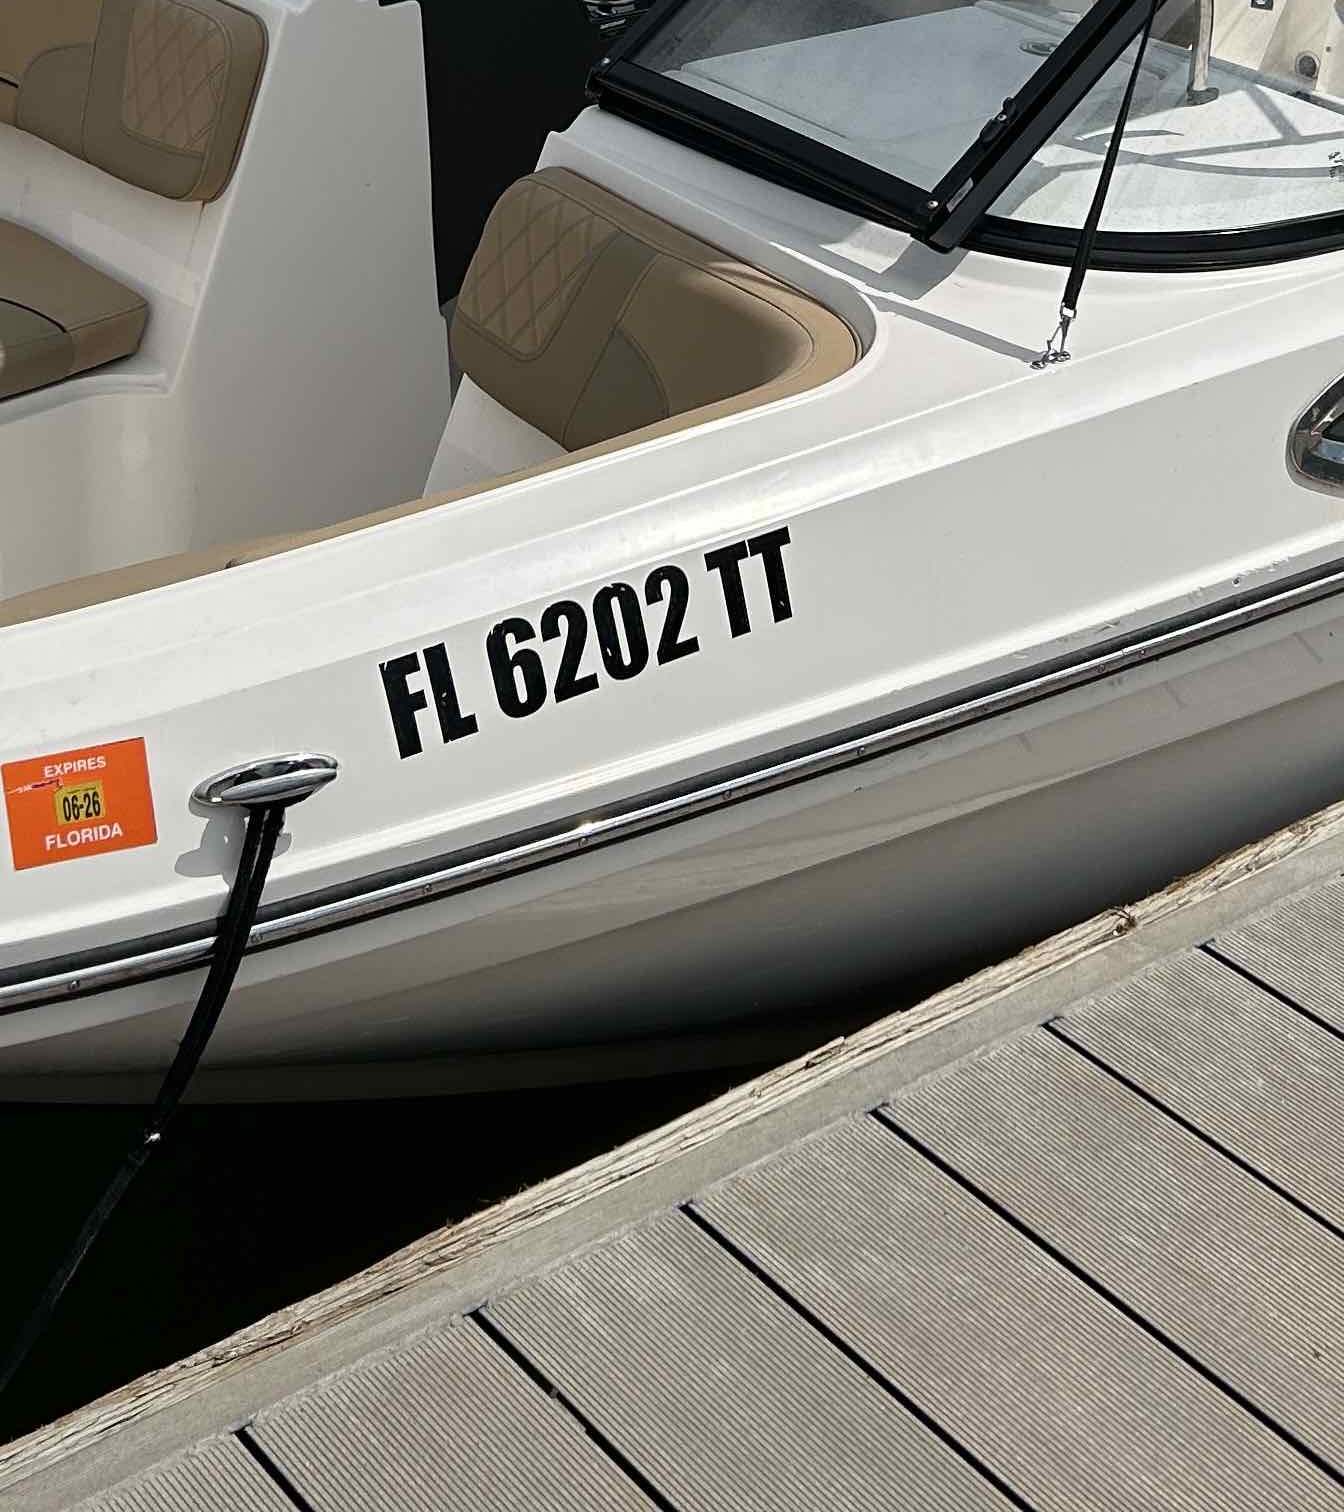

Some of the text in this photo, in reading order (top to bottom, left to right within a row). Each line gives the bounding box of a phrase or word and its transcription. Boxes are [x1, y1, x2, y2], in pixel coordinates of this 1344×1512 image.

[379, 526, 792, 760] FL 6202 TT
[43, 756, 107, 778] EXPIRES
[62, 791, 101, 822] 06-26
[45, 822, 123, 851] FLORIDA
